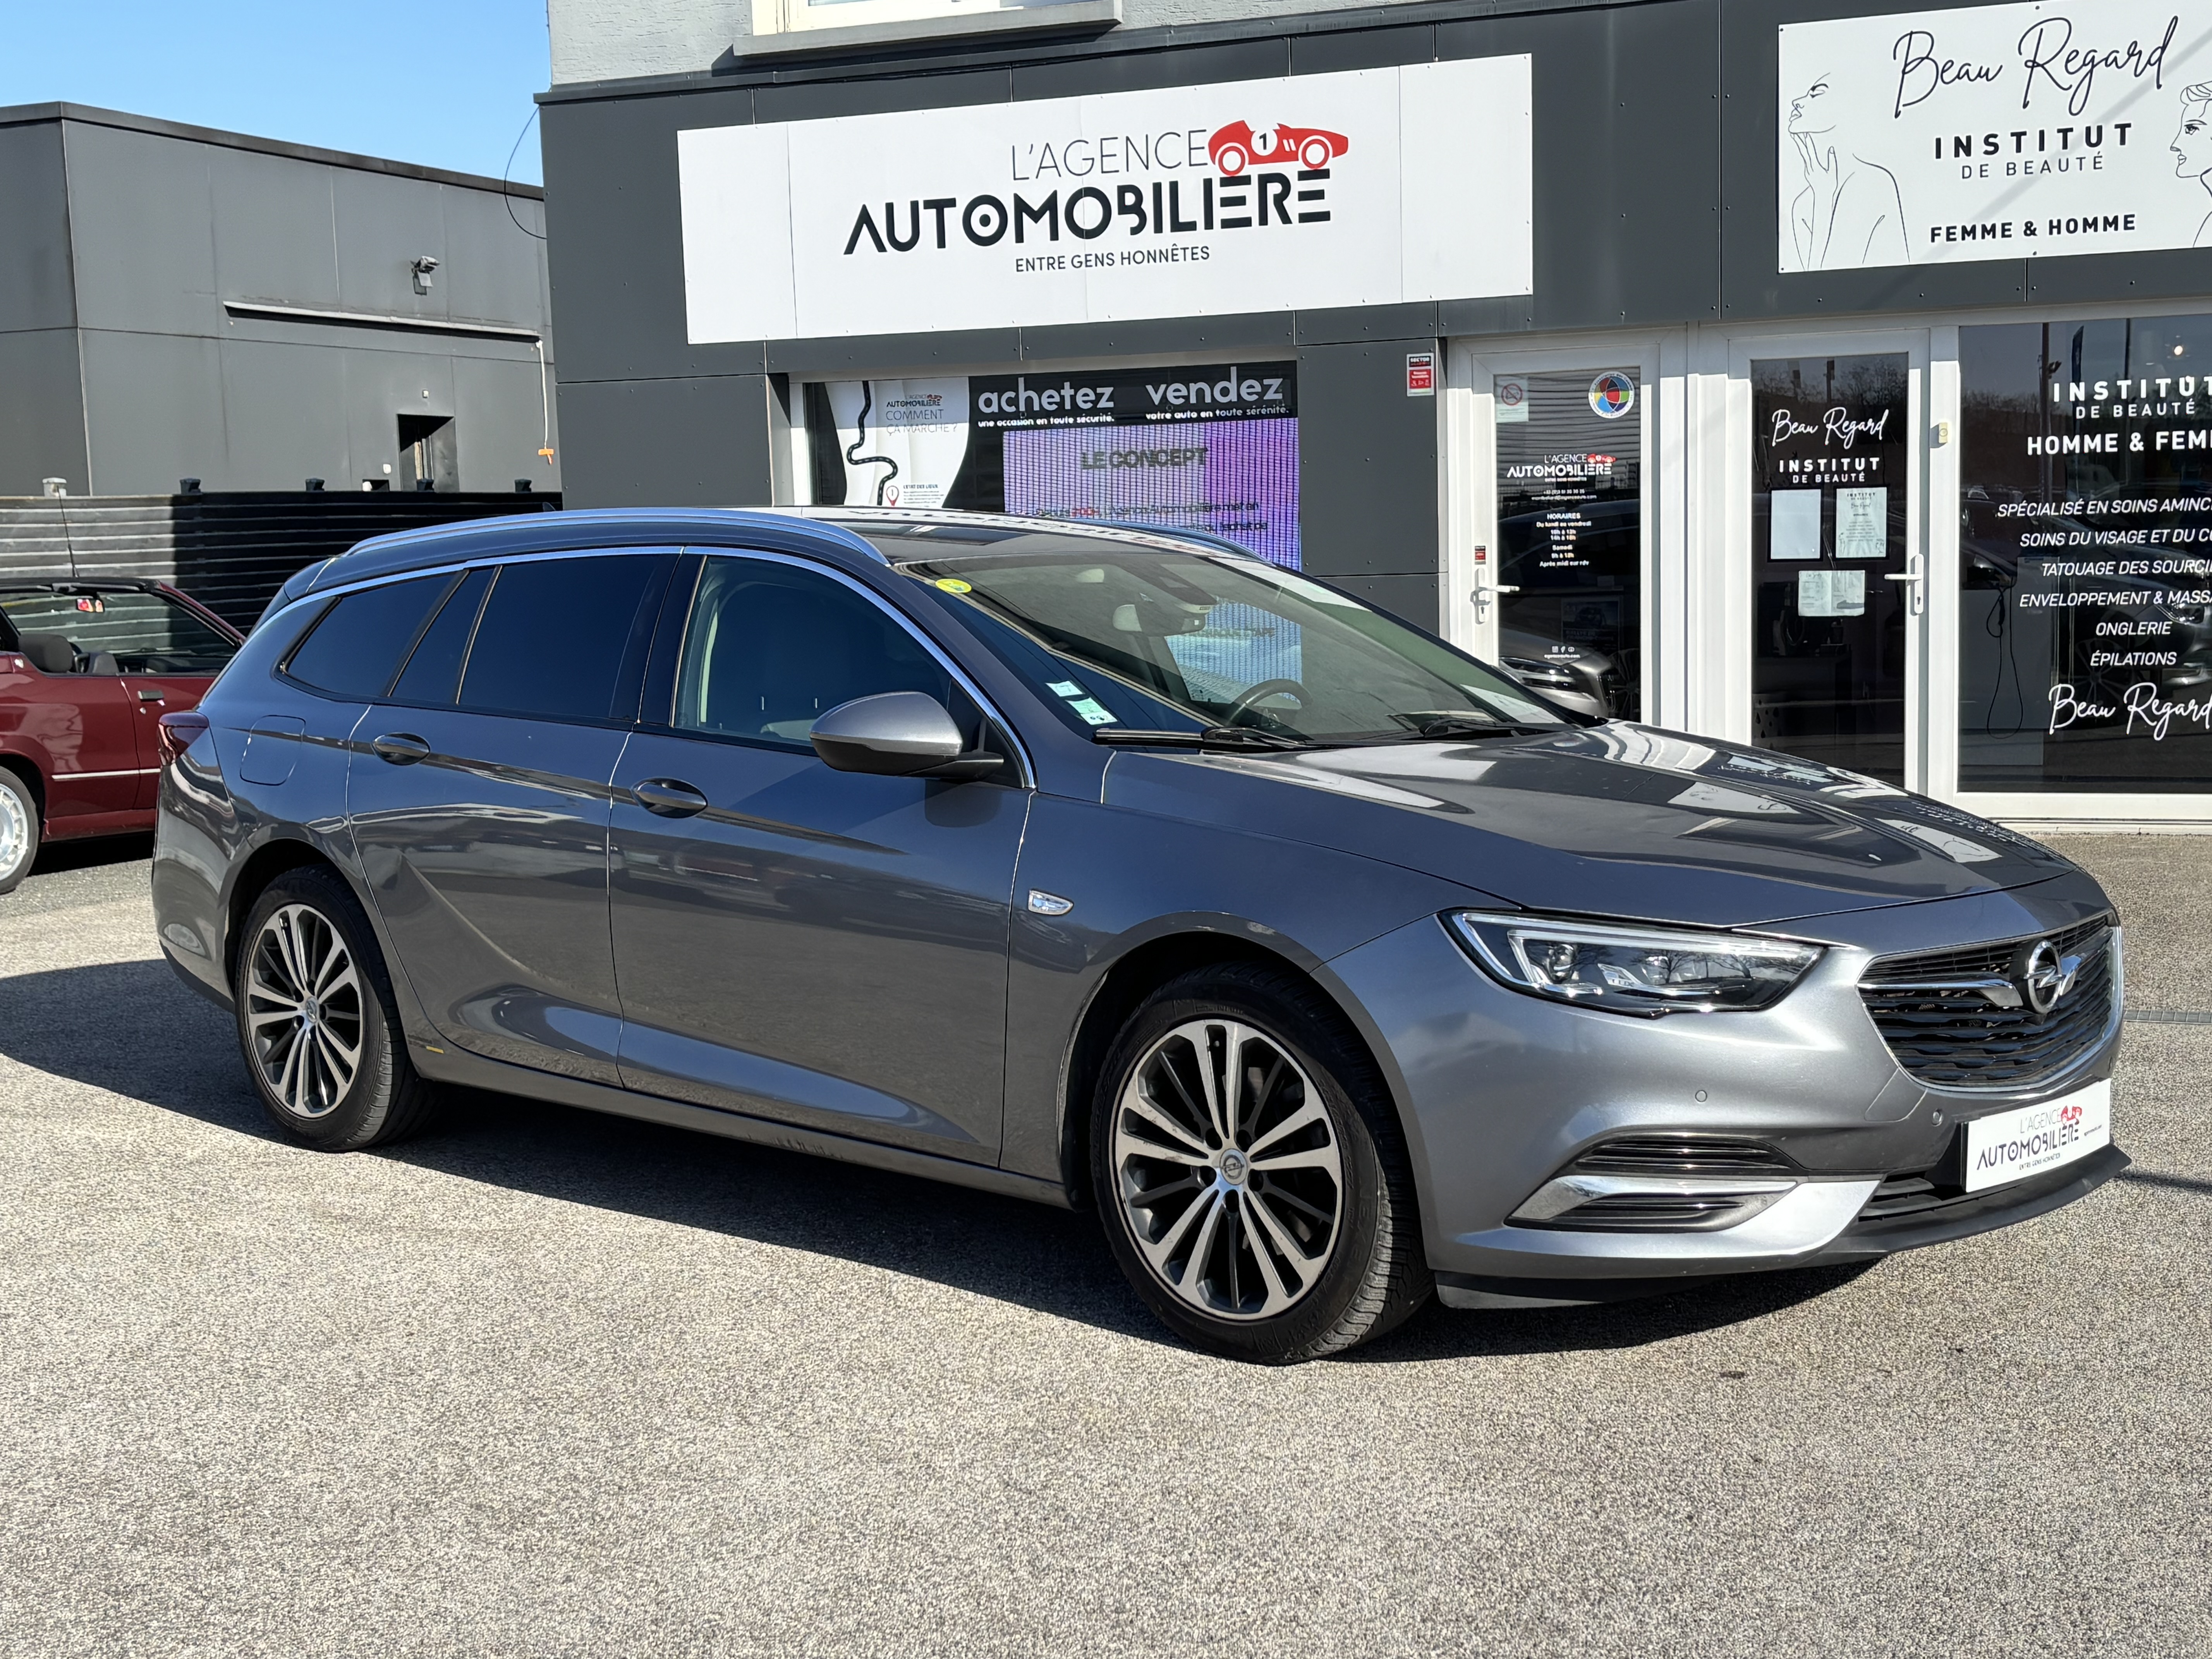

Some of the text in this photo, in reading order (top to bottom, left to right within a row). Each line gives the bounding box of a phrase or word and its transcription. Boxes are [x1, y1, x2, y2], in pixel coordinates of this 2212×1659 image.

[1893, 15, 2178, 119] Beau Regard
[1936, 123, 2131, 159] INSTITUT
[1012, 129, 1208, 181] L'AGENCE
[1962, 152, 2102, 179] DE BEAUTÉ
[1931, 214, 2135, 243] FEMME & HOMME
[1016, 243, 1209, 272] ENTRE GENS HONNÊTES
[978, 377, 1114, 413] achetez
[1146, 366, 1283, 405] vendez
[2053, 375, 2212, 402] INSTITUT
[886, 409, 943, 421] COMMENT
[1146, 411, 1172, 420] votre
[1174, 410, 1197, 419] auto
[1216, 408, 1242, 416] toute
[1245, 404, 1290, 416] sérénité.
[2076, 398, 2195, 419] DE BEAUTÉ
[887, 424, 900, 436] ÇA
[903, 423, 950, 433] MARCHE
[996, 416, 1034, 428] occasion
[1050, 416, 1074, 424] toute
[1077, 412, 1115, 423] sécurité.
[1771, 406, 1890, 450] Beau Regard
[2028, 429, 2212, 455] HOMME & FEM
[1544, 454, 1587, 464] L'AGENCE
[1779, 457, 1880, 472] INSTITUT
[1792, 472, 1865, 483] DE BEAUTÉ
[1997, 497, 2212, 517] SPÉCIALISÉ EN SOINS AMINC
[2020, 532, 2065, 547] SOINS
[2068, 531, 2092, 547] DU
[2095, 530, 2148, 545] VISAGE
[2149, 527, 2171, 544] ET
[2172, 527, 2196, 543] DU
[2042, 562, 2116, 577] TATOUAGE
[2119, 560, 2149, 574] DES
[2019, 589, 2212, 607] ENVELOPPEMENT & MASS
[2095, 621, 2172, 636] ONGLERIE
[2090, 650, 2177, 666] ÉPILATIONS
[2048, 683, 2117, 736] Beau
[2020, 1108, 2062, 1133] L'AGENCE
